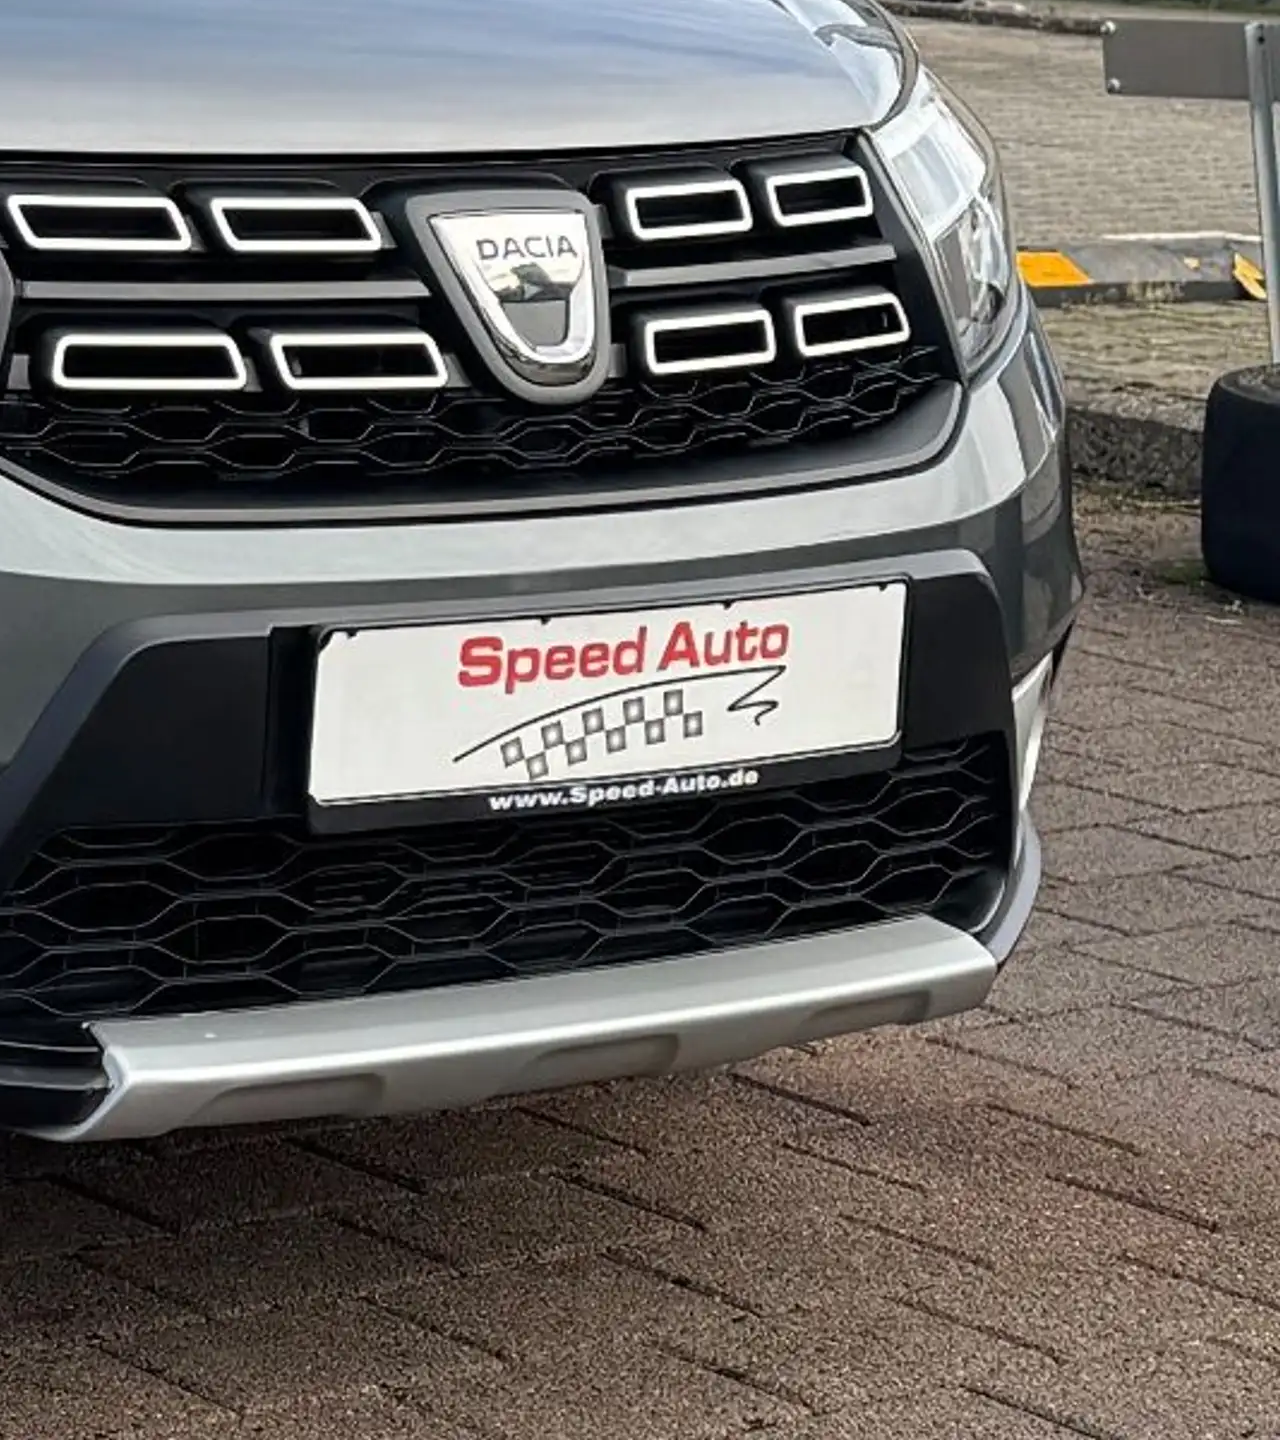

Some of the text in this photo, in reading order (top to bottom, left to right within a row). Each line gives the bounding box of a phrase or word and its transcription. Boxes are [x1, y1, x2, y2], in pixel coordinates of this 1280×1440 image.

[476, 235, 578, 260] DACIA
[458, 620, 790, 694] Speed Auto
[490, 767, 760, 811] www.Speed-Auto.de
